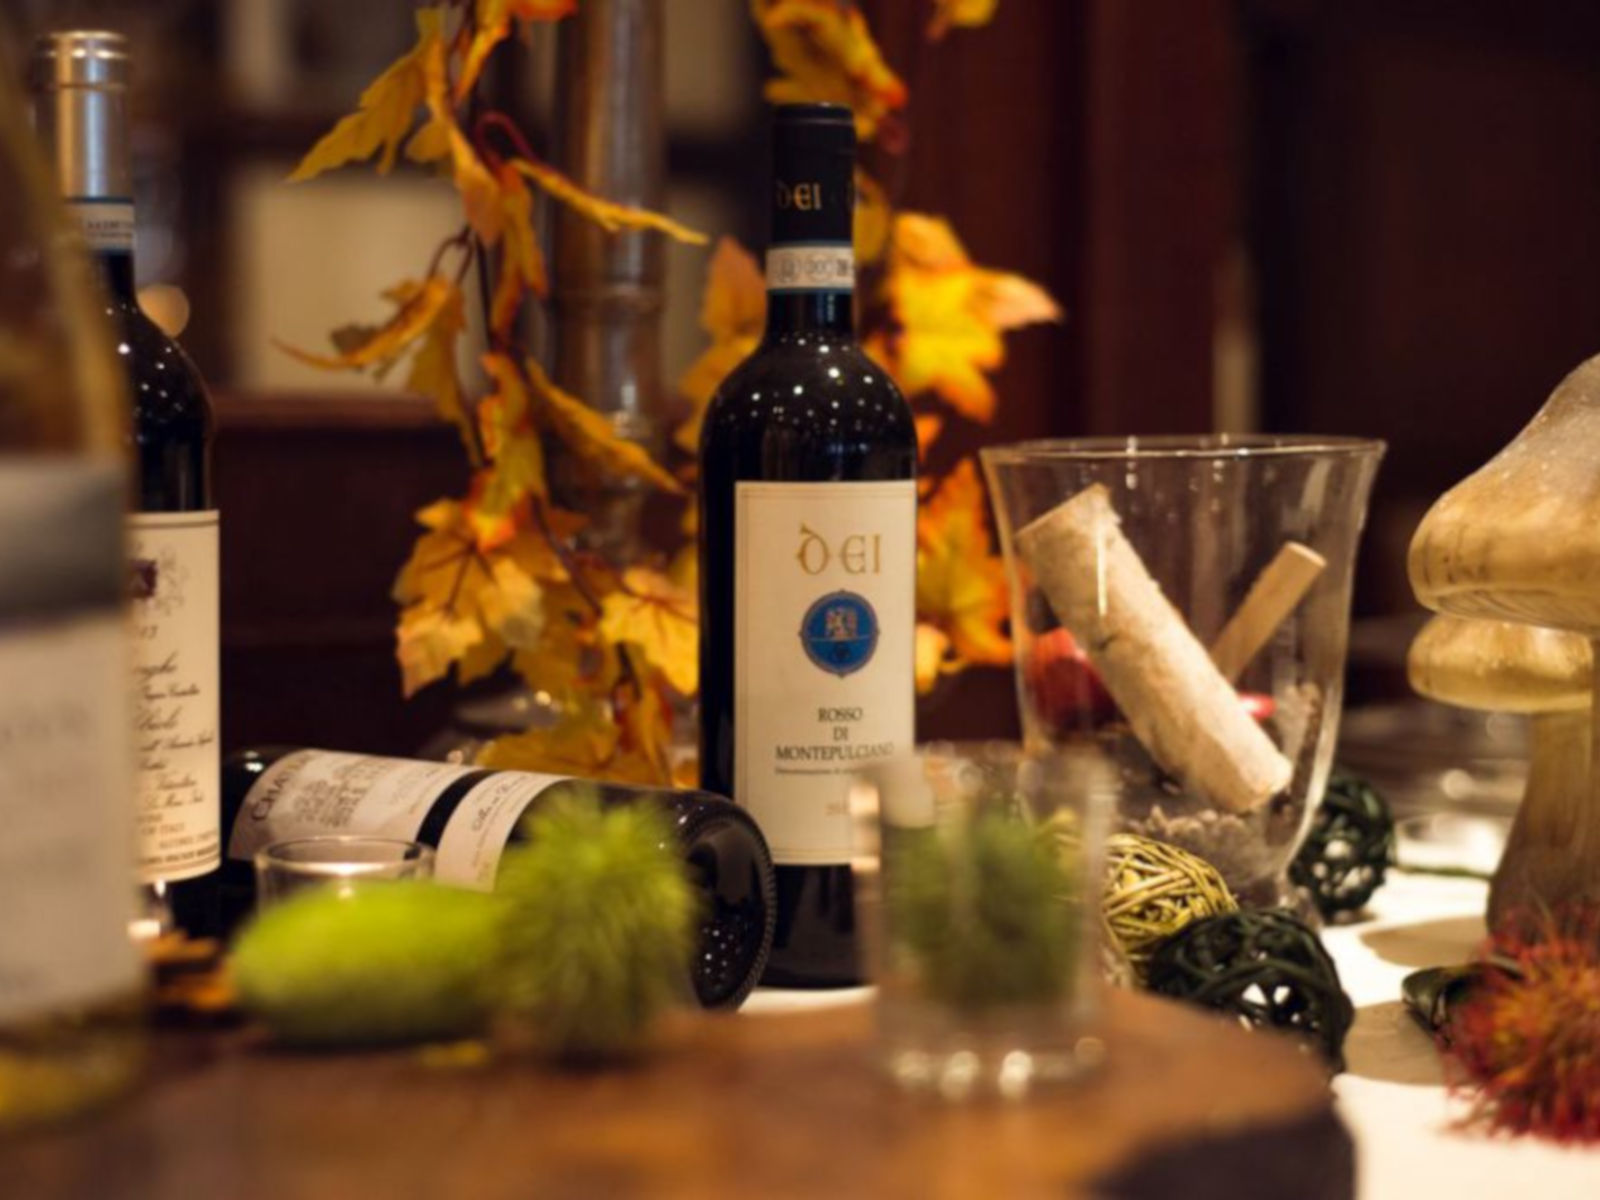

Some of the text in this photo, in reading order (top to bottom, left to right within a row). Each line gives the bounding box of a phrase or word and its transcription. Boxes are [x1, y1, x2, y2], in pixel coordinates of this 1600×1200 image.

[796, 524, 881, 575] DEI
[817, 707, 863, 722] ROSSO
[833, 726, 848, 741] DI
[775, 741, 894, 761] MONTEPULCIANO
